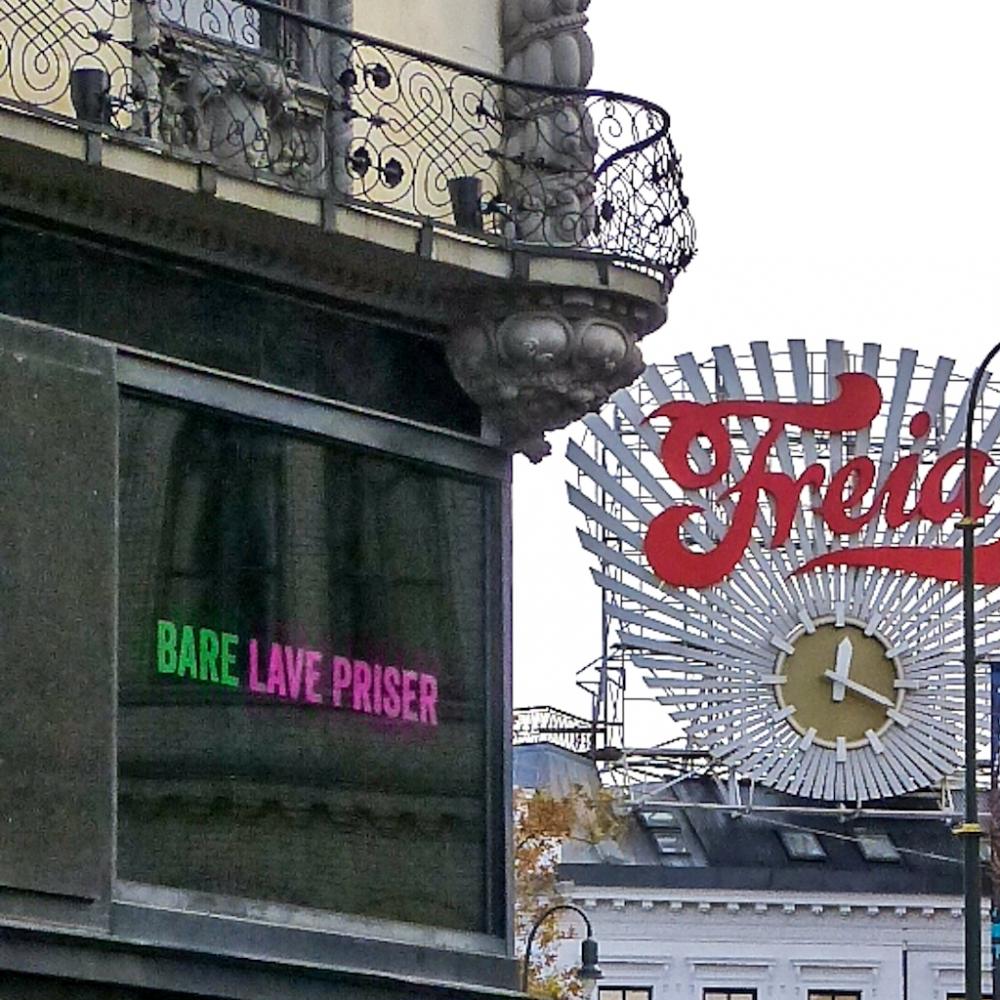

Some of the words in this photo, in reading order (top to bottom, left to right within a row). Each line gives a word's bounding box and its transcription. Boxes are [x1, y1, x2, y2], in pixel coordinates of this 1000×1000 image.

[157, 619, 240, 687] BARE
[249, 638, 323, 703] LAVE
[332, 655, 438, 726] PRISER
